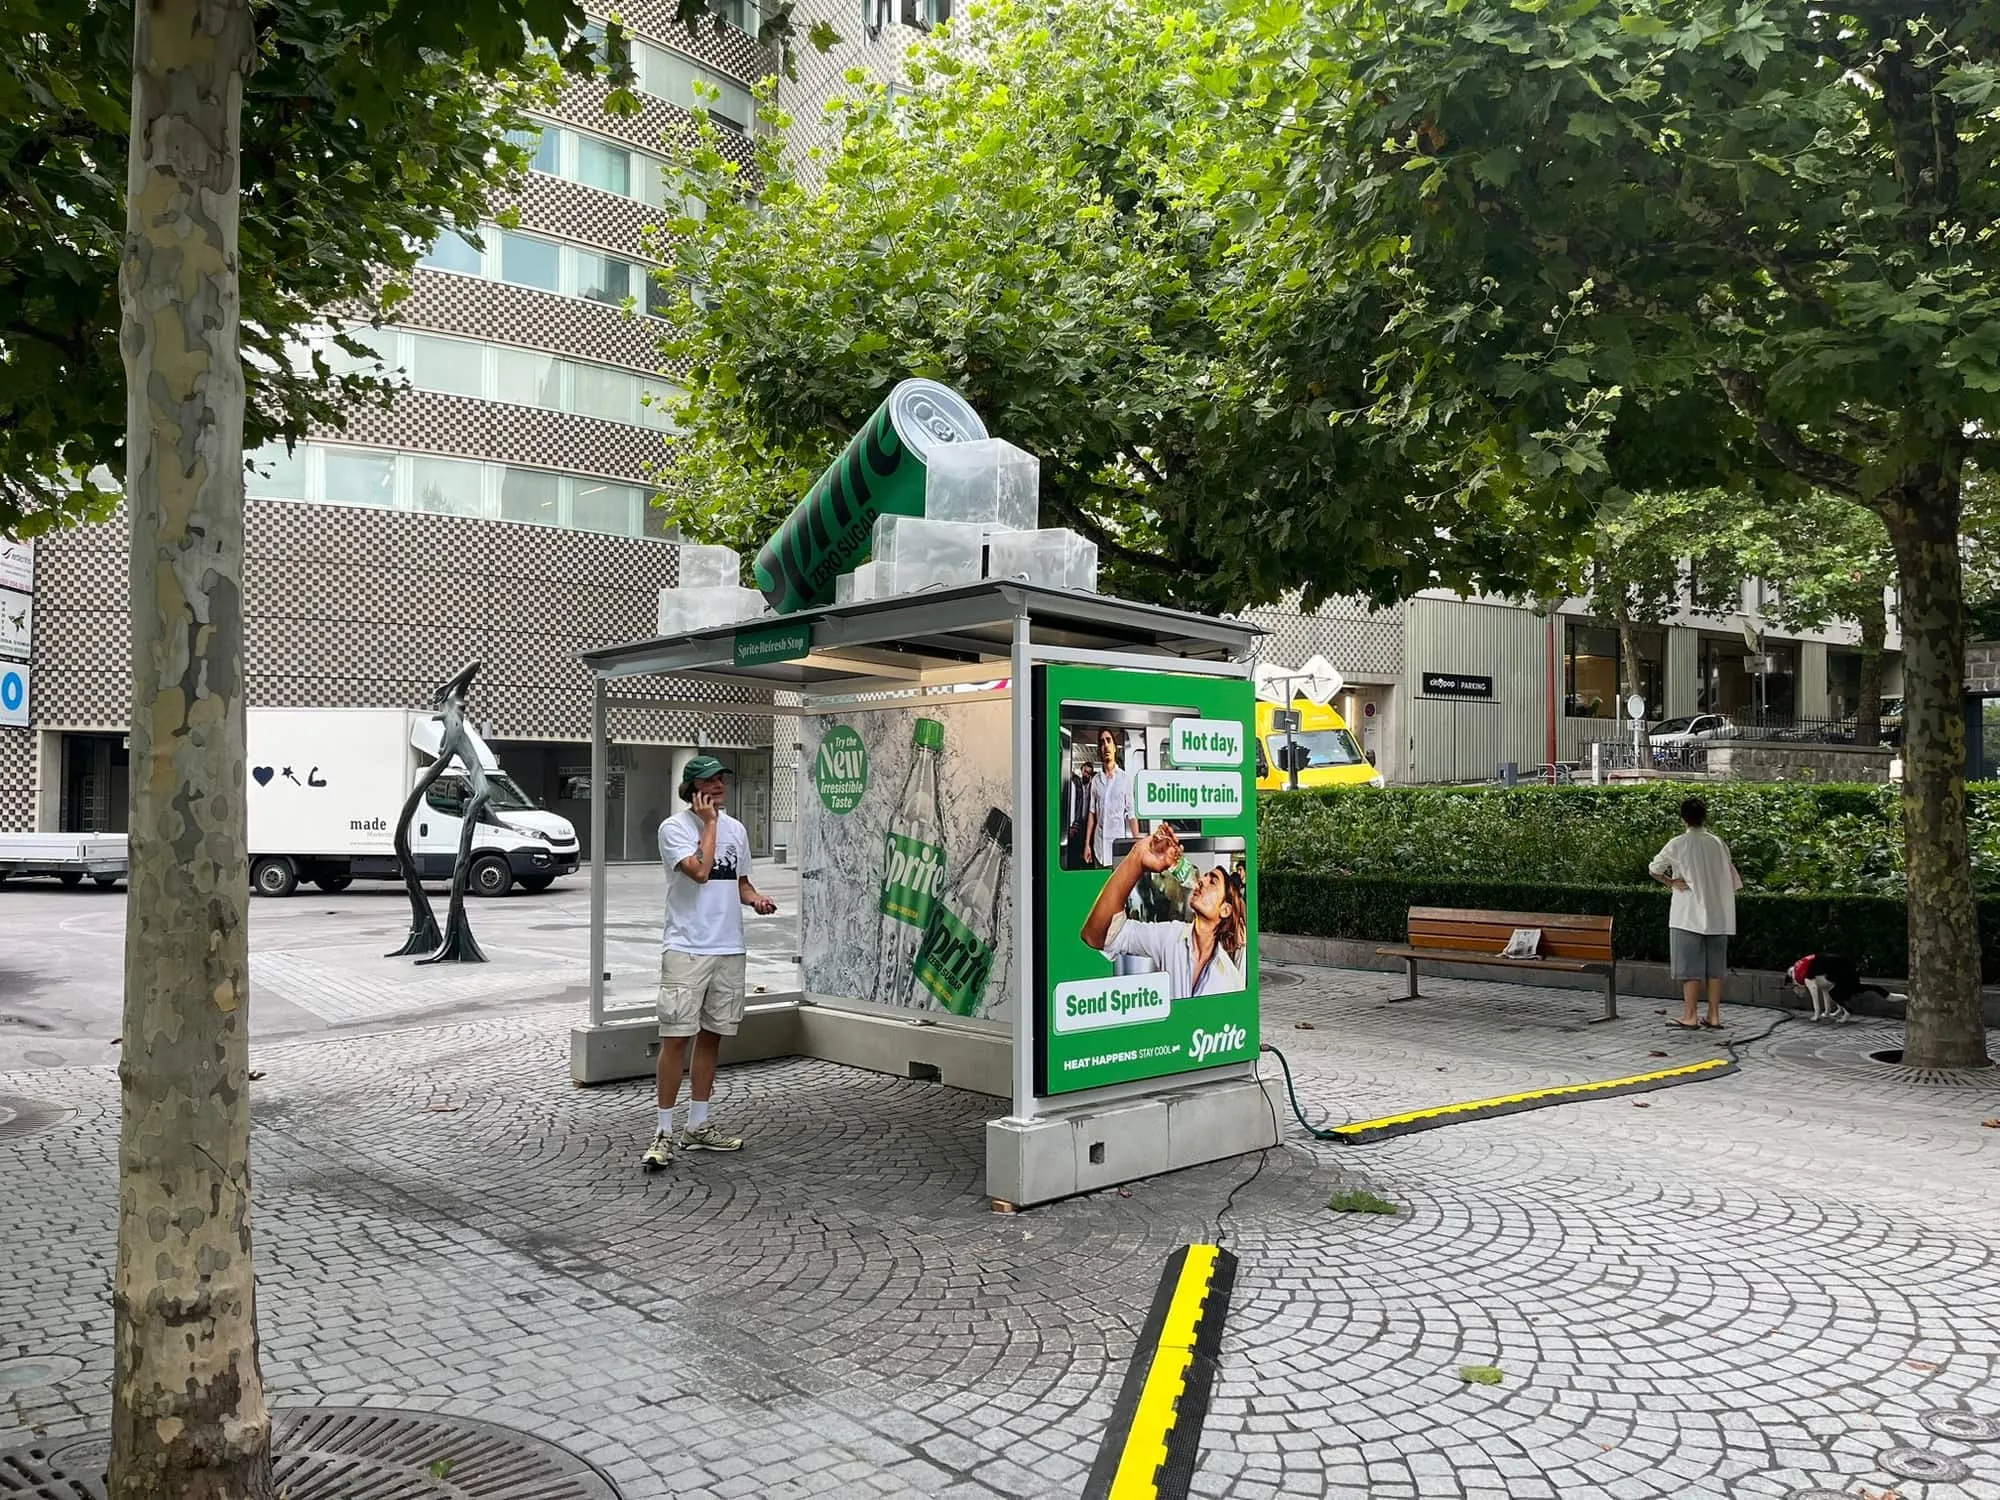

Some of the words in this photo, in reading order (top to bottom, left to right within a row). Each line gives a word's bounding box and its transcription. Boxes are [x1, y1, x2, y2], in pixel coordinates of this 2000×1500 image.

[810, 550, 842, 590] ZERO
[737, 644, 759, 659] Sprite
[760, 639, 786, 653] Refresh
[787, 637, 804, 650] Stop
[835, 737, 846, 749] Try
[846, 736, 857, 747] the
[1182, 730, 1207, 751] Hot
[1210, 732, 1238, 757] day.
[820, 743, 863, 779] New
[820, 781, 863, 794] Irresistible
[1147, 782, 1198, 808] Boiling
[1201, 784, 1238, 804] train.
[831, 796, 853, 808] Taste
[350, 817, 386, 830] made
[883, 838, 944, 898] Sprite
[1066, 991, 1107, 1017] Send
[1110, 987, 1163, 1015] Sprite.
[1188, 1023, 1247, 1063] Sprite
[1063, 1057, 1091, 1071] HEAT
[1091, 1050, 1138, 1067] HAPPENS
[1139, 1049, 1154, 1059] STAY
[1154, 1045, 1172, 1057] COOL
